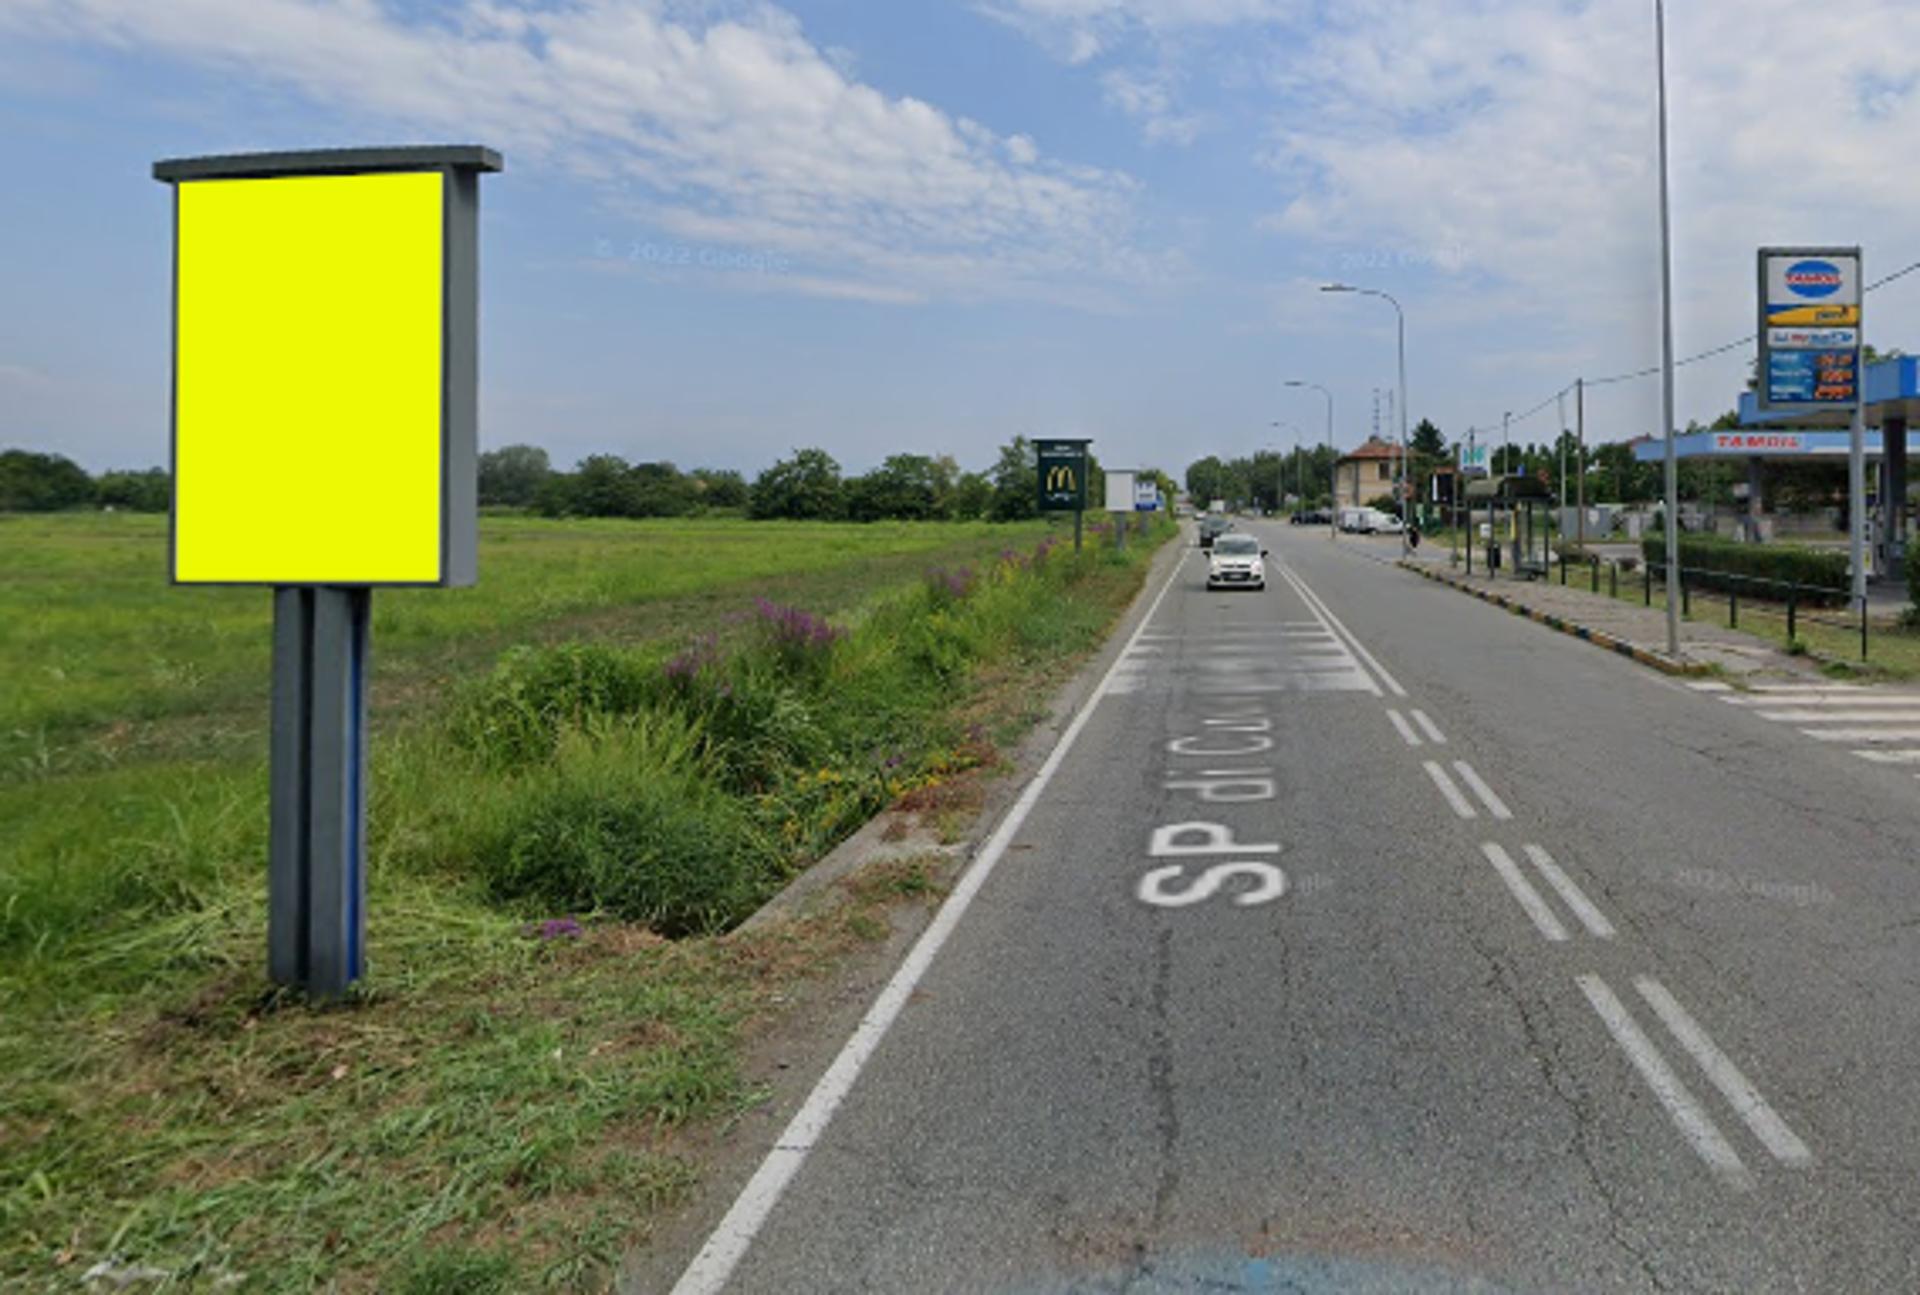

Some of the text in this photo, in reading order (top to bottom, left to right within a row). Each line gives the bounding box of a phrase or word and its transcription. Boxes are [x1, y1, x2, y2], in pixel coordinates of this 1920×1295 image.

[1717, 434, 1799, 448] TAMOIL
[1162, 767, 1275, 802] di
[1137, 820, 1285, 907] SP
